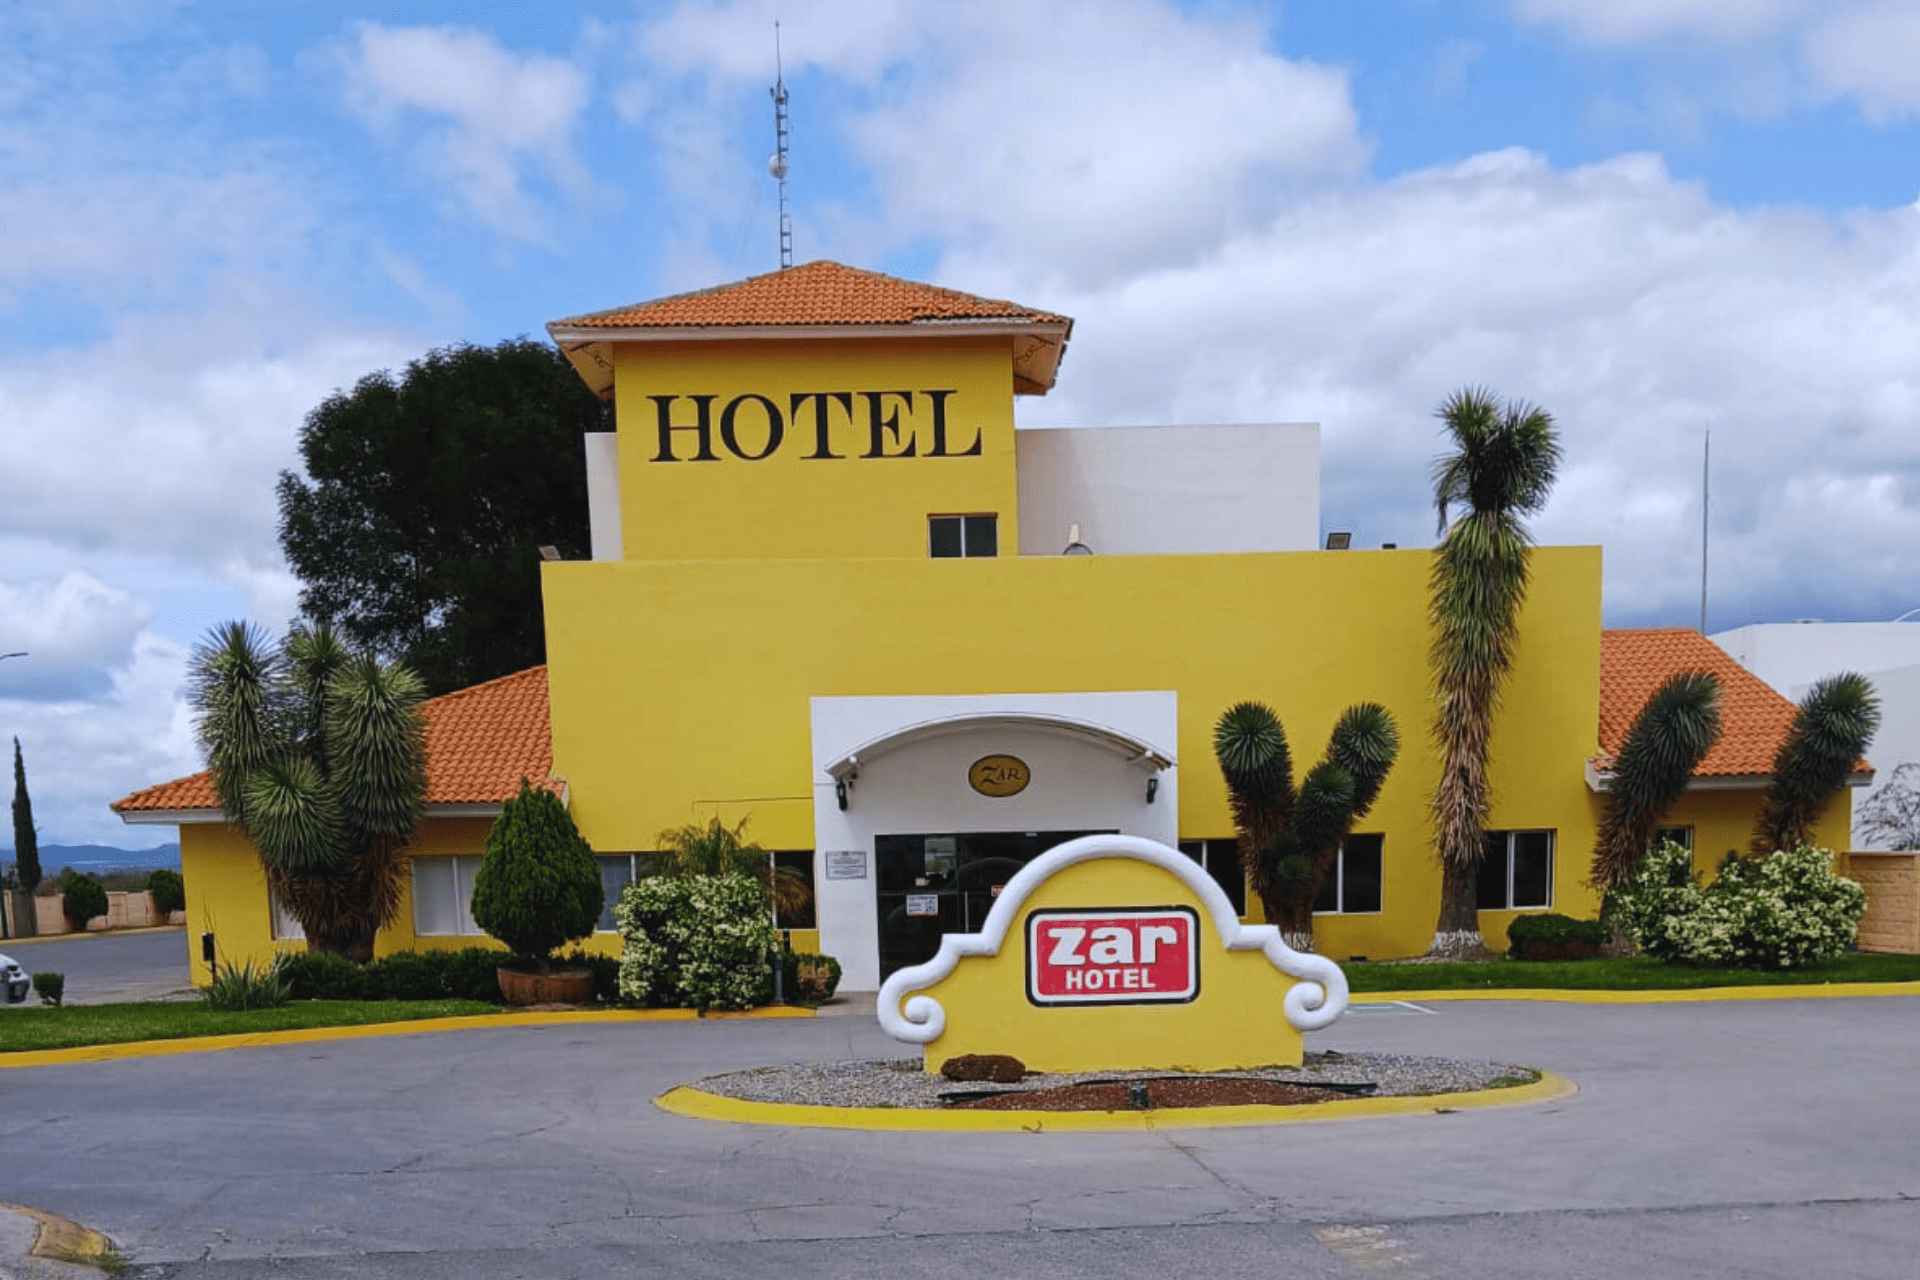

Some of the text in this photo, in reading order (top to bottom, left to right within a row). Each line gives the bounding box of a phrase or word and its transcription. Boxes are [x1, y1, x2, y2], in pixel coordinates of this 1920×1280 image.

[646, 389, 983, 463] HOTEL
[980, 766, 1022, 787] ZAR
[1048, 926, 1179, 966] zar
[1065, 968, 1157, 990] HOTEL
